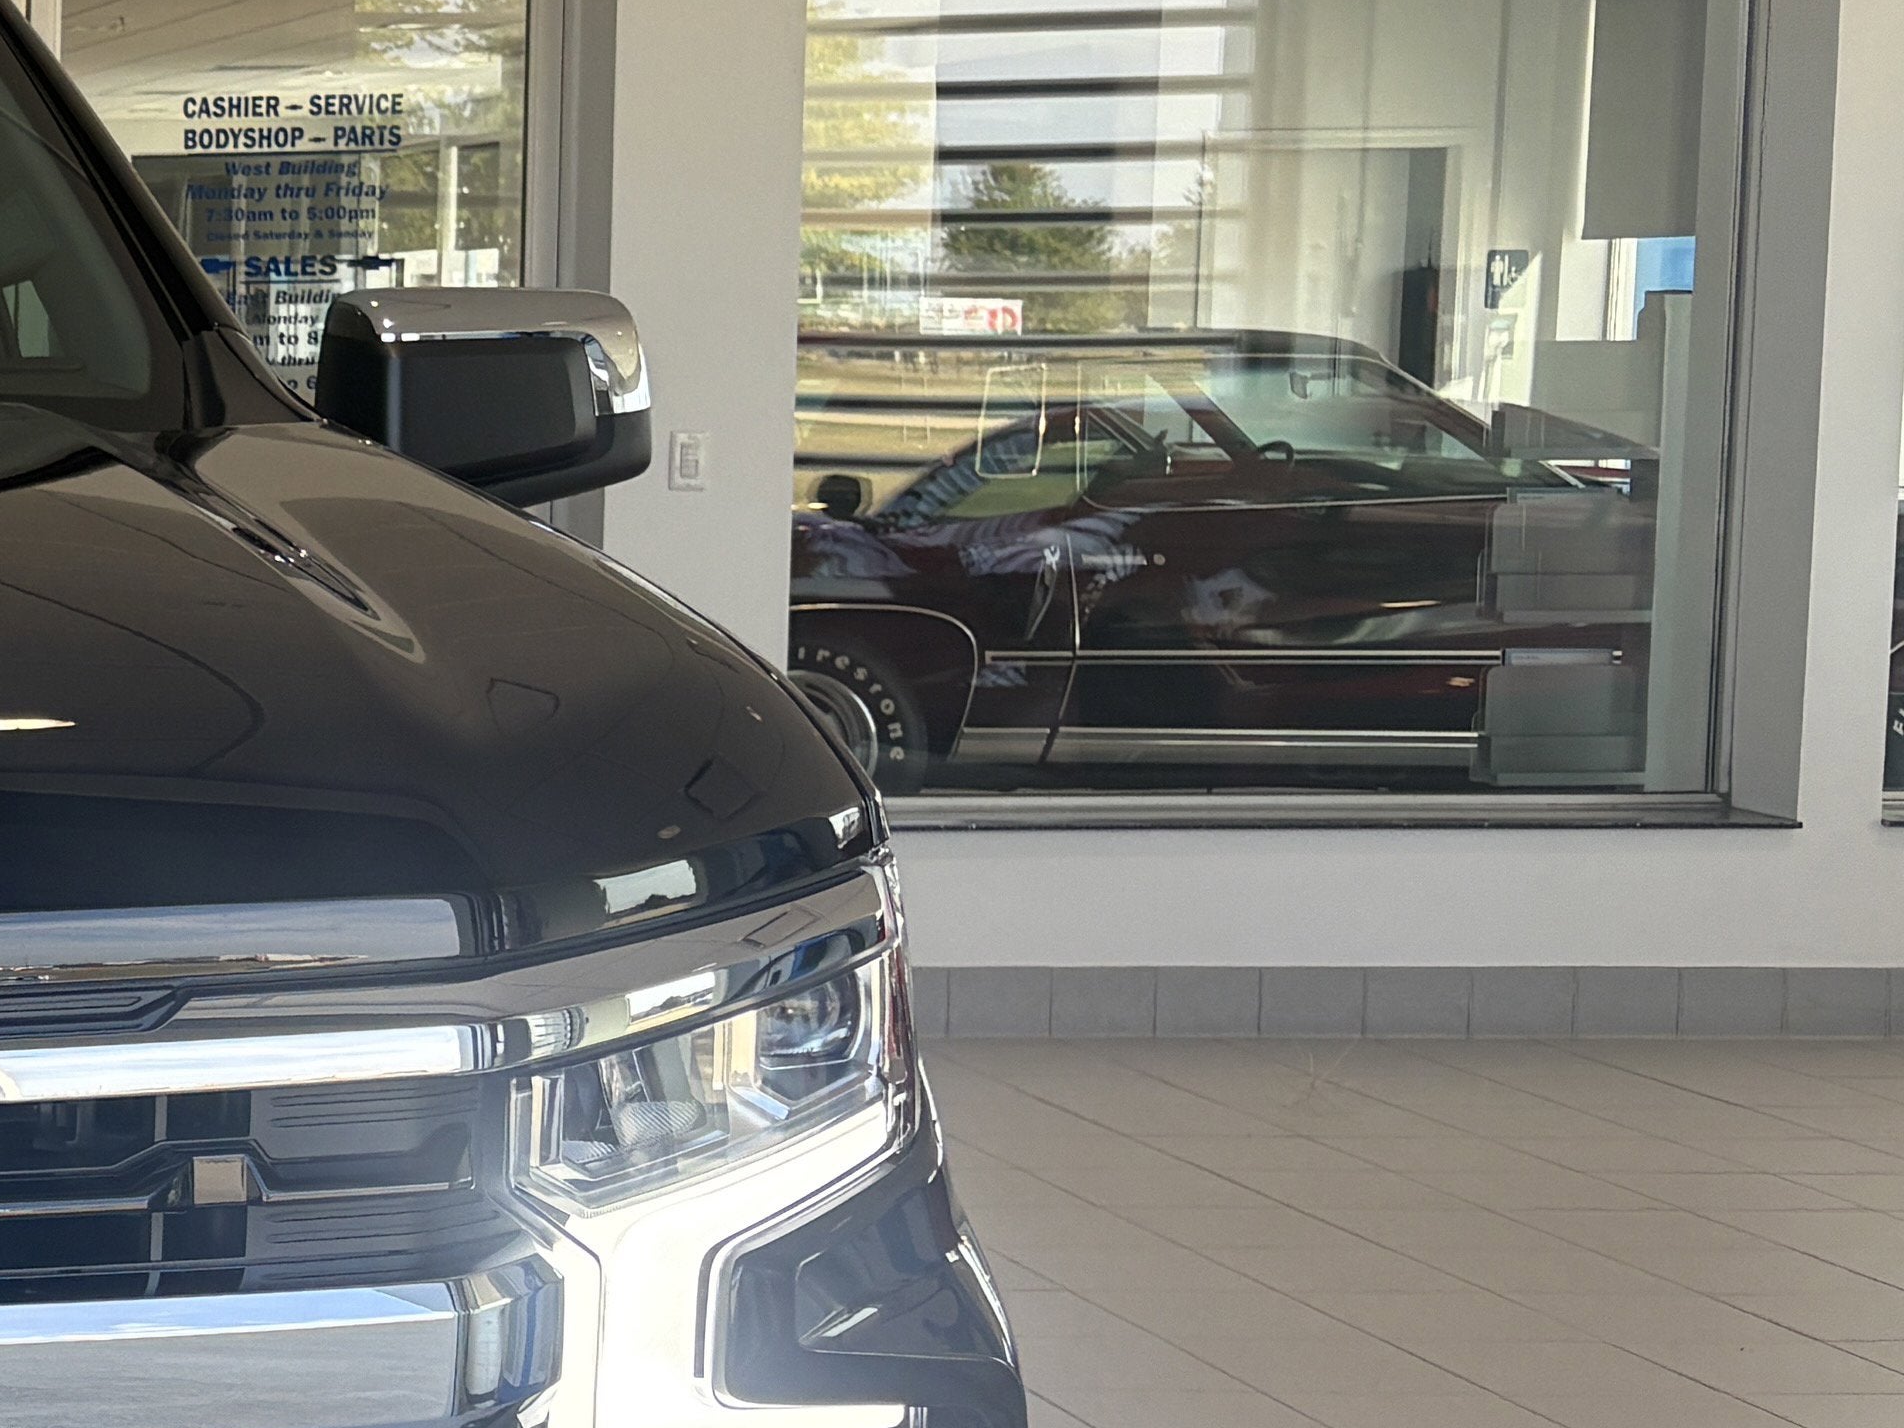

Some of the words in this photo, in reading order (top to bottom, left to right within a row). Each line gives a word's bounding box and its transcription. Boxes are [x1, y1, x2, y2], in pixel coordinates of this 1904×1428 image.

[182, 95, 280, 119] CASHIER
[309, 93, 404, 116] SERVICE
[183, 126, 304, 150] BODYSHOP
[333, 124, 402, 147] PARTS
[225, 160, 273, 178] West
[278, 159, 359, 178] Building
[186, 183, 268, 202] Monday
[275, 182, 316, 200] thru
[324, 181, 390, 202] Friday
[281, 207, 300, 222] to
[307, 206, 377, 223] 5:00pm
[244, 254, 339, 277] SALES
[274, 288, 339, 305] Buildi
